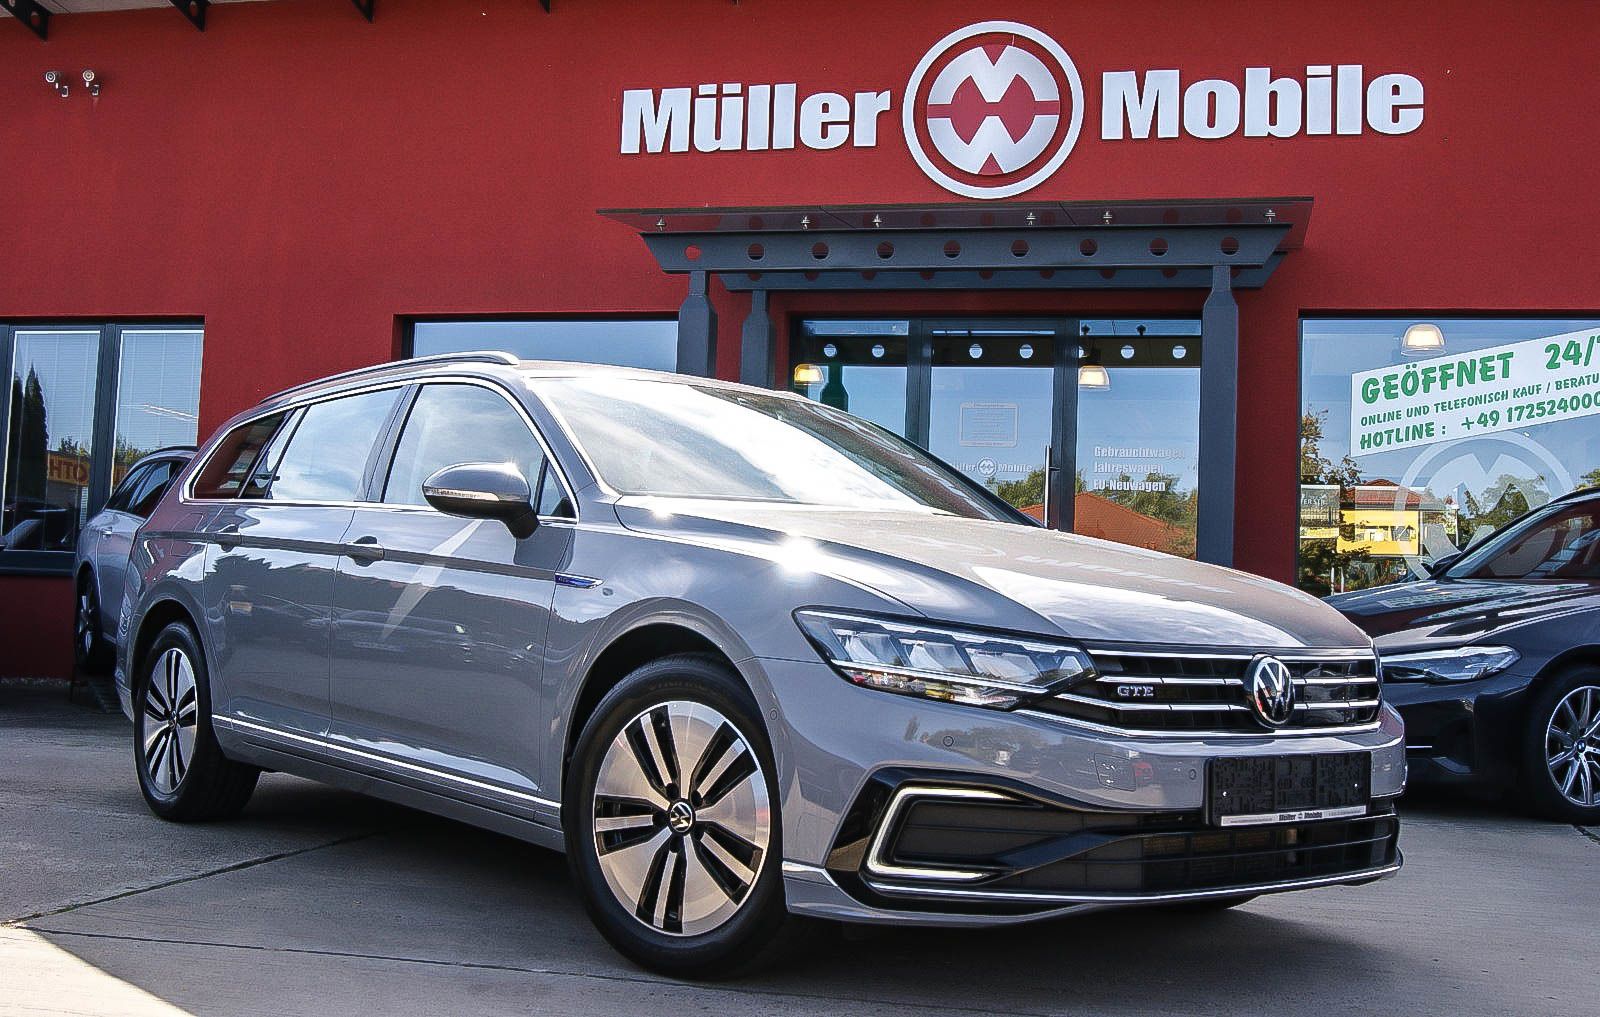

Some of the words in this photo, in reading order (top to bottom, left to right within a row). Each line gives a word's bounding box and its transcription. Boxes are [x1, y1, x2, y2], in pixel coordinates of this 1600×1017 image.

[620, 83, 891, 154] Müller
[1101, 65, 1424, 139] Mobile
[1361, 352, 1514, 404] GEÖFFNET
[1544, 336, 1600, 370] 24/
[1360, 410, 1402, 427] ONLINE
[1406, 405, 1430, 418] UND
[1434, 390, 1509, 413] TELEFONISCH
[1513, 384, 1542, 399] KAUF
[1360, 422, 1435, 449] HOTLINE
[1461, 410, 1500, 430] +49
[1093, 446, 1185, 459] Gebrauchtwagen
[1093, 462, 1164, 474] Jahreswagen
[1093, 479, 1166, 492] EU-Neuwagen
[1117, 685, 1154, 697] GTE
